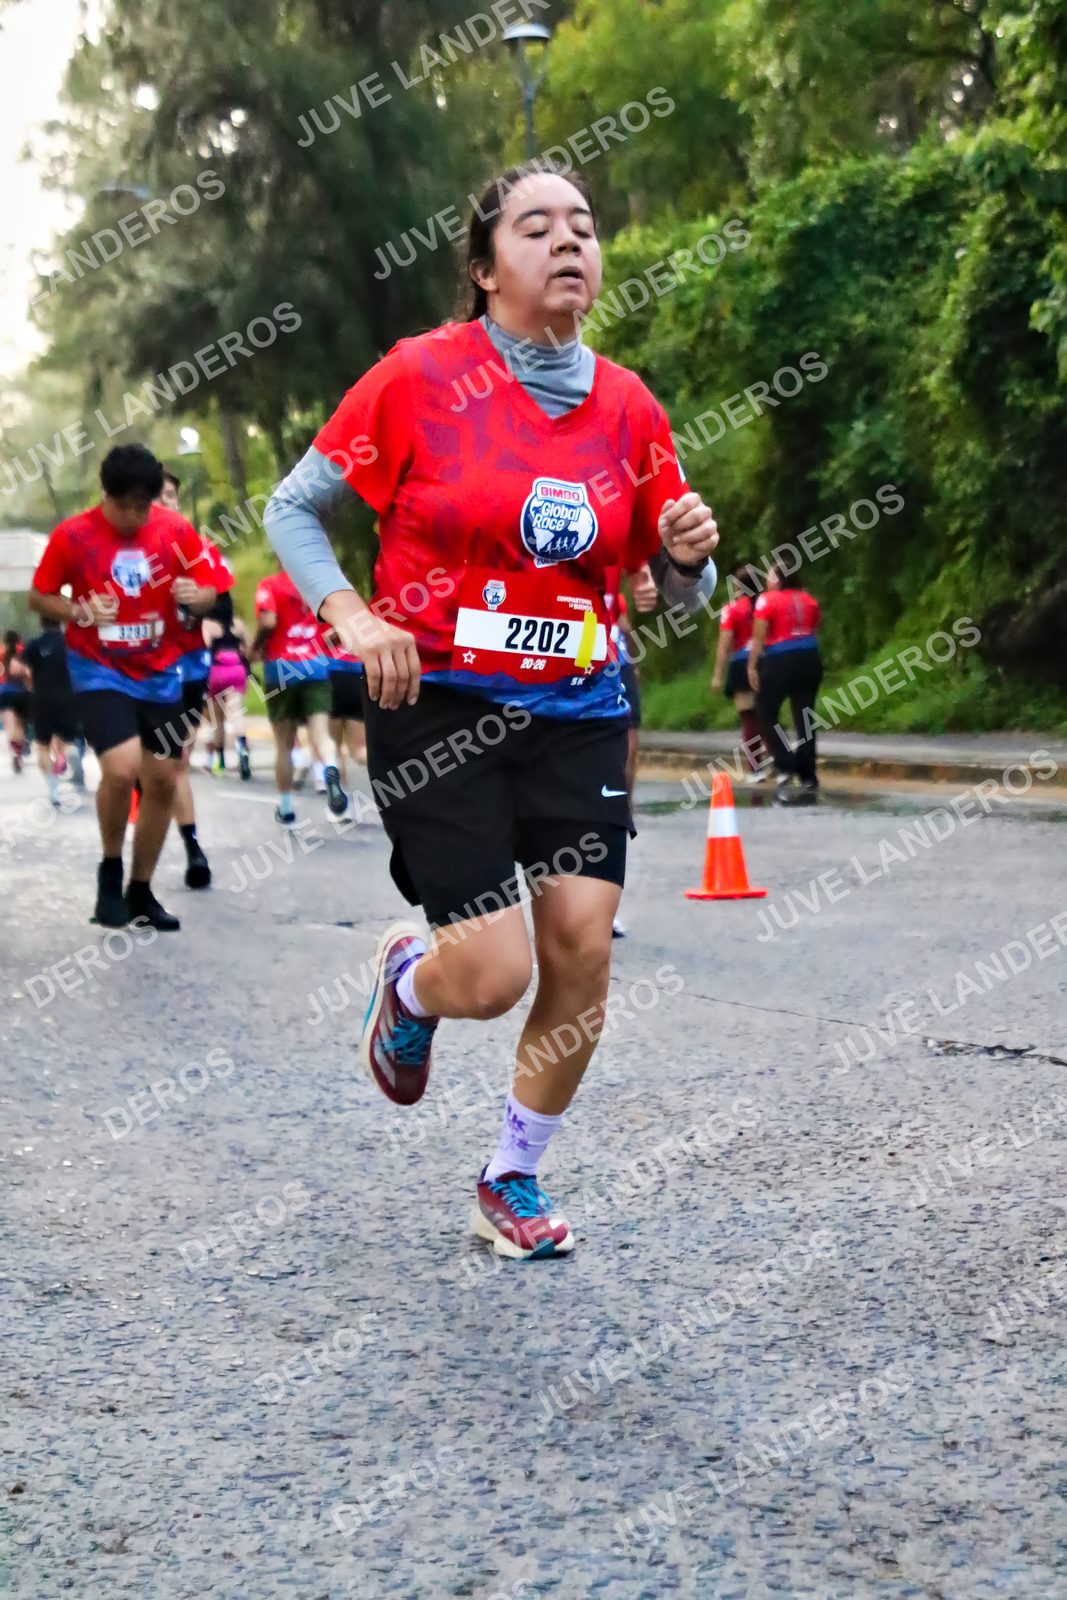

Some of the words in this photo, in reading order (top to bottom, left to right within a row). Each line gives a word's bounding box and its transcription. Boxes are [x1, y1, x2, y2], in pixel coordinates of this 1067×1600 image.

[540, 485, 581, 502] BIMBO
[541, 502, 581, 522] Global
[533, 513, 566, 532] Race
[505, 617, 570, 654] 2202
